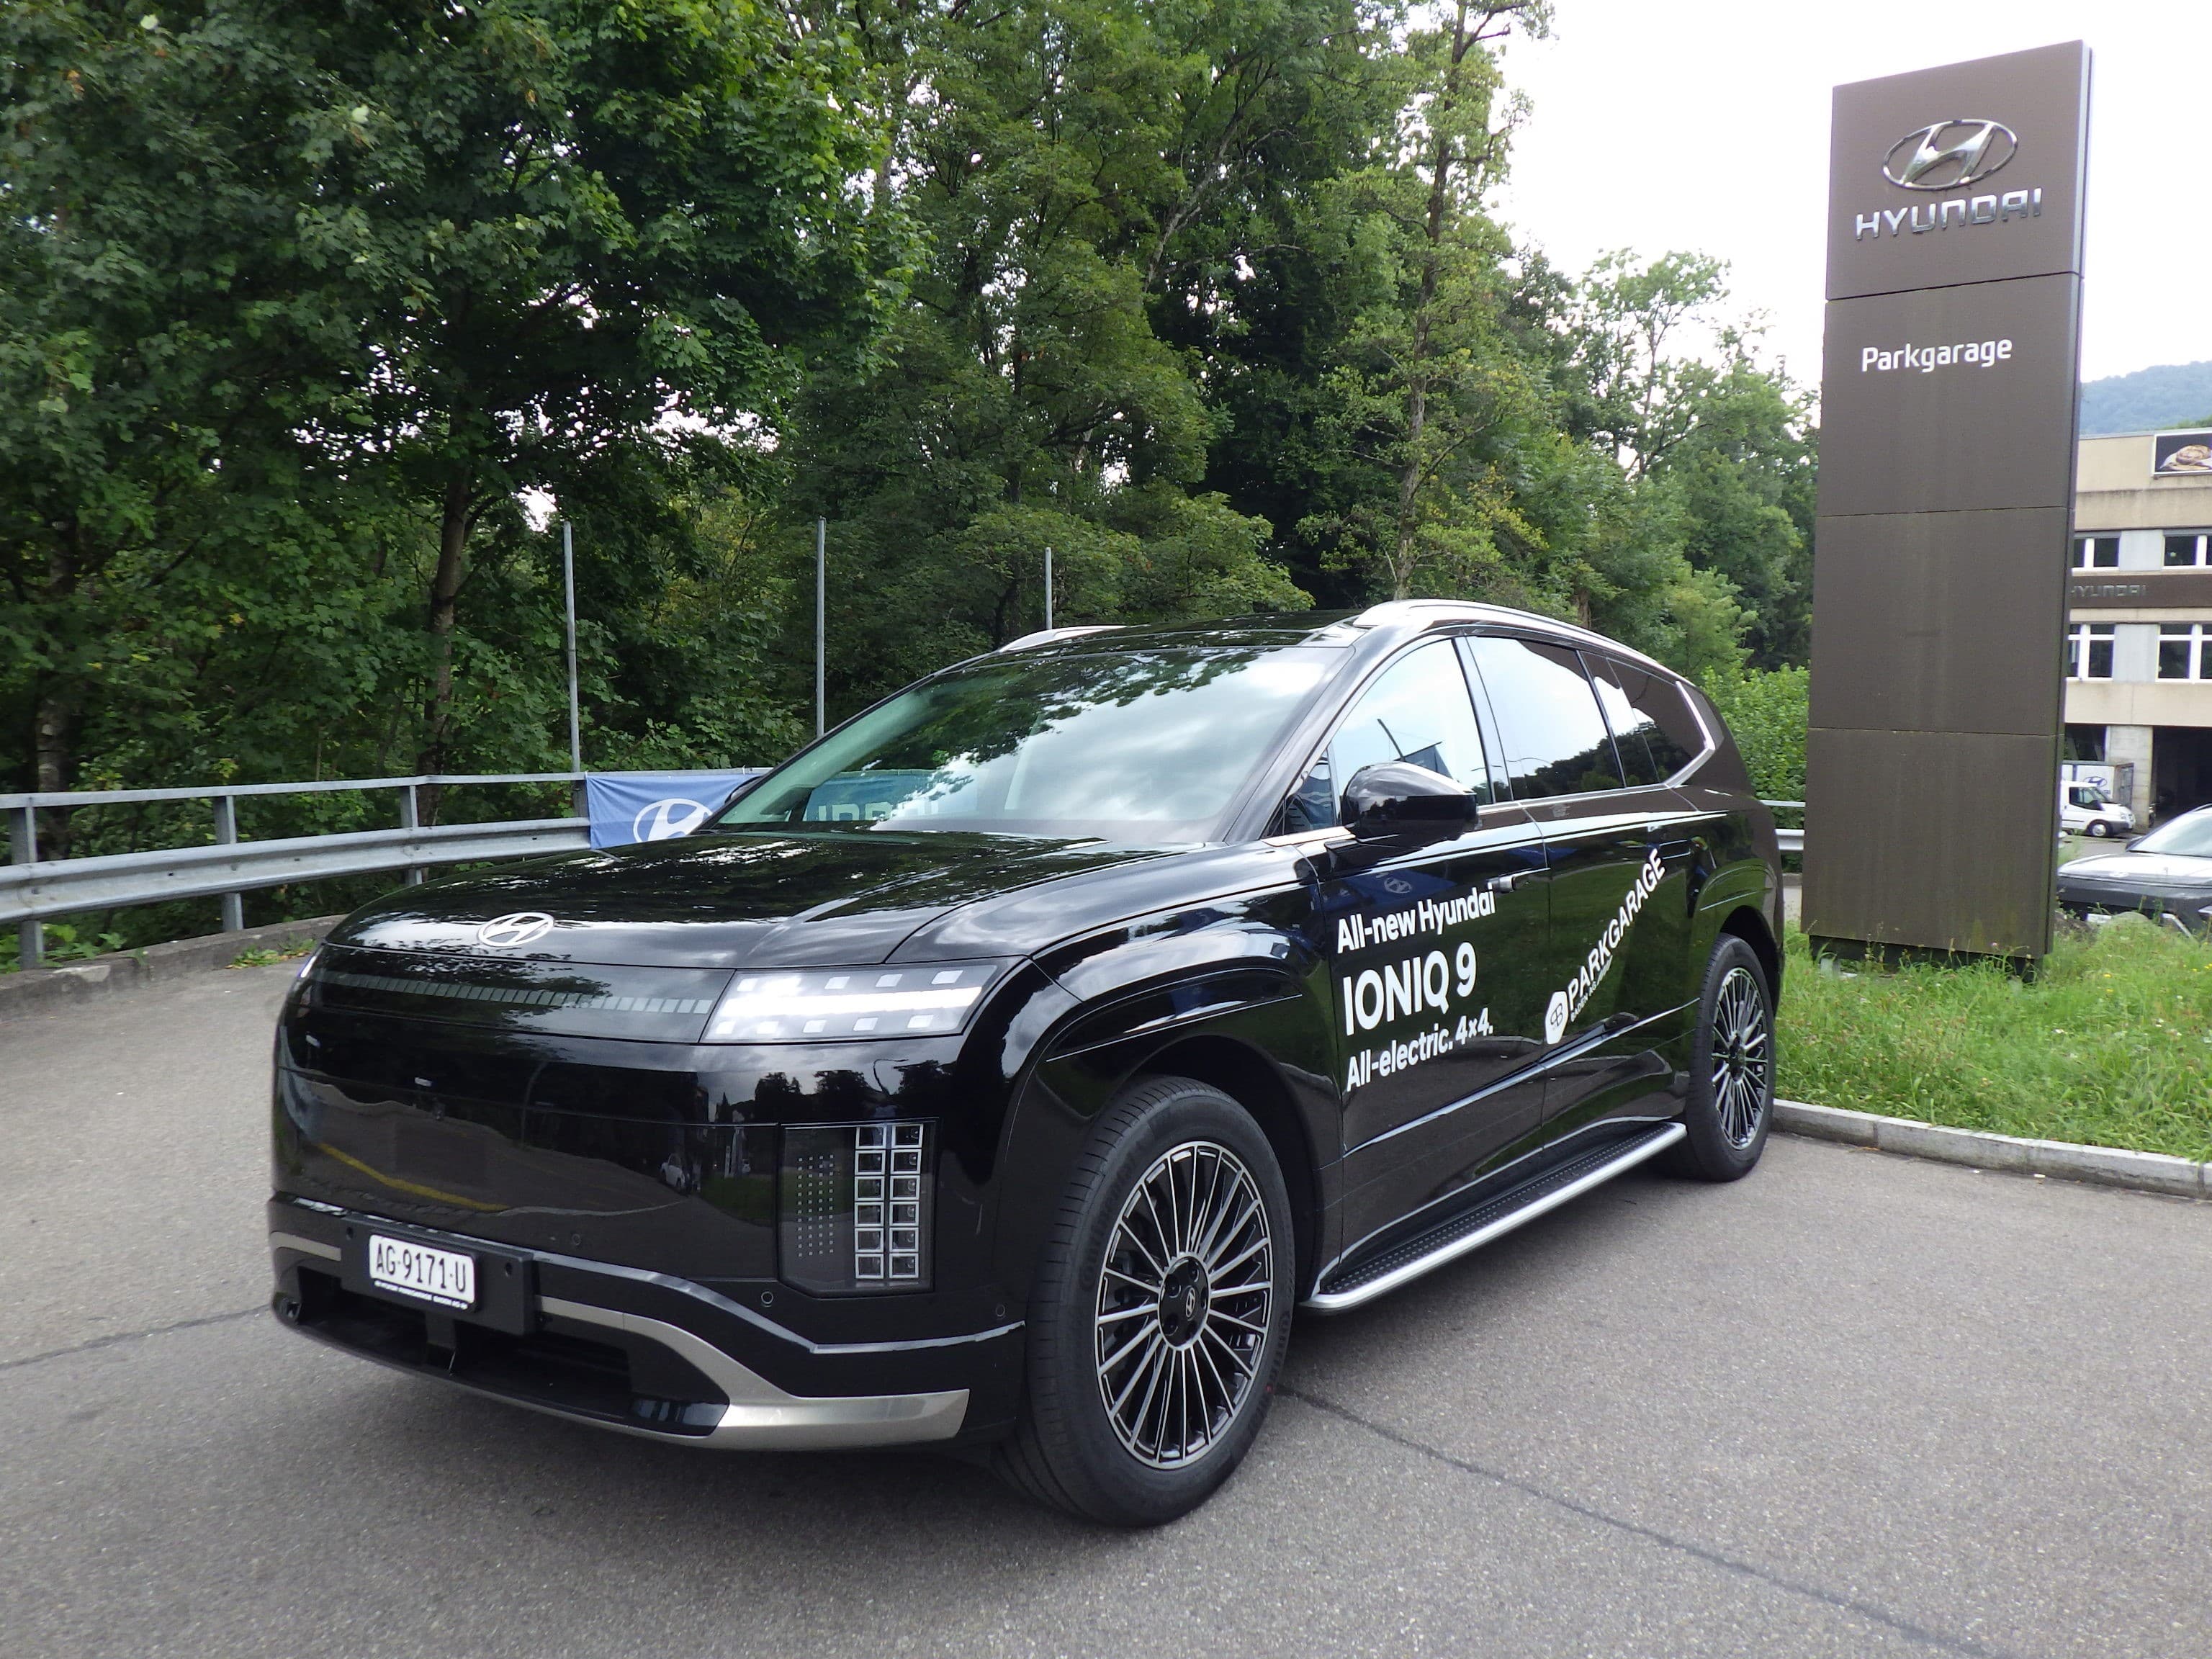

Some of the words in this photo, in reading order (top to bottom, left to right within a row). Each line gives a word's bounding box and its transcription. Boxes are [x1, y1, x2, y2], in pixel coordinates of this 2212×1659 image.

[1855, 187, 2043, 240] HYUNDAI
[1861, 339, 2013, 373] Parkgarage
[1337, 909, 1416, 954] All-new
[1418, 881, 1496, 935] Hyundai
[1568, 848, 1665, 1011] PARKGARAGE
[1343, 950, 1449, 1036] IONIQ
[1456, 942, 1476, 997] 9
[1346, 1023, 1454, 1092] All-electric.
[1455, 1007, 1493, 1045] 4x4.
